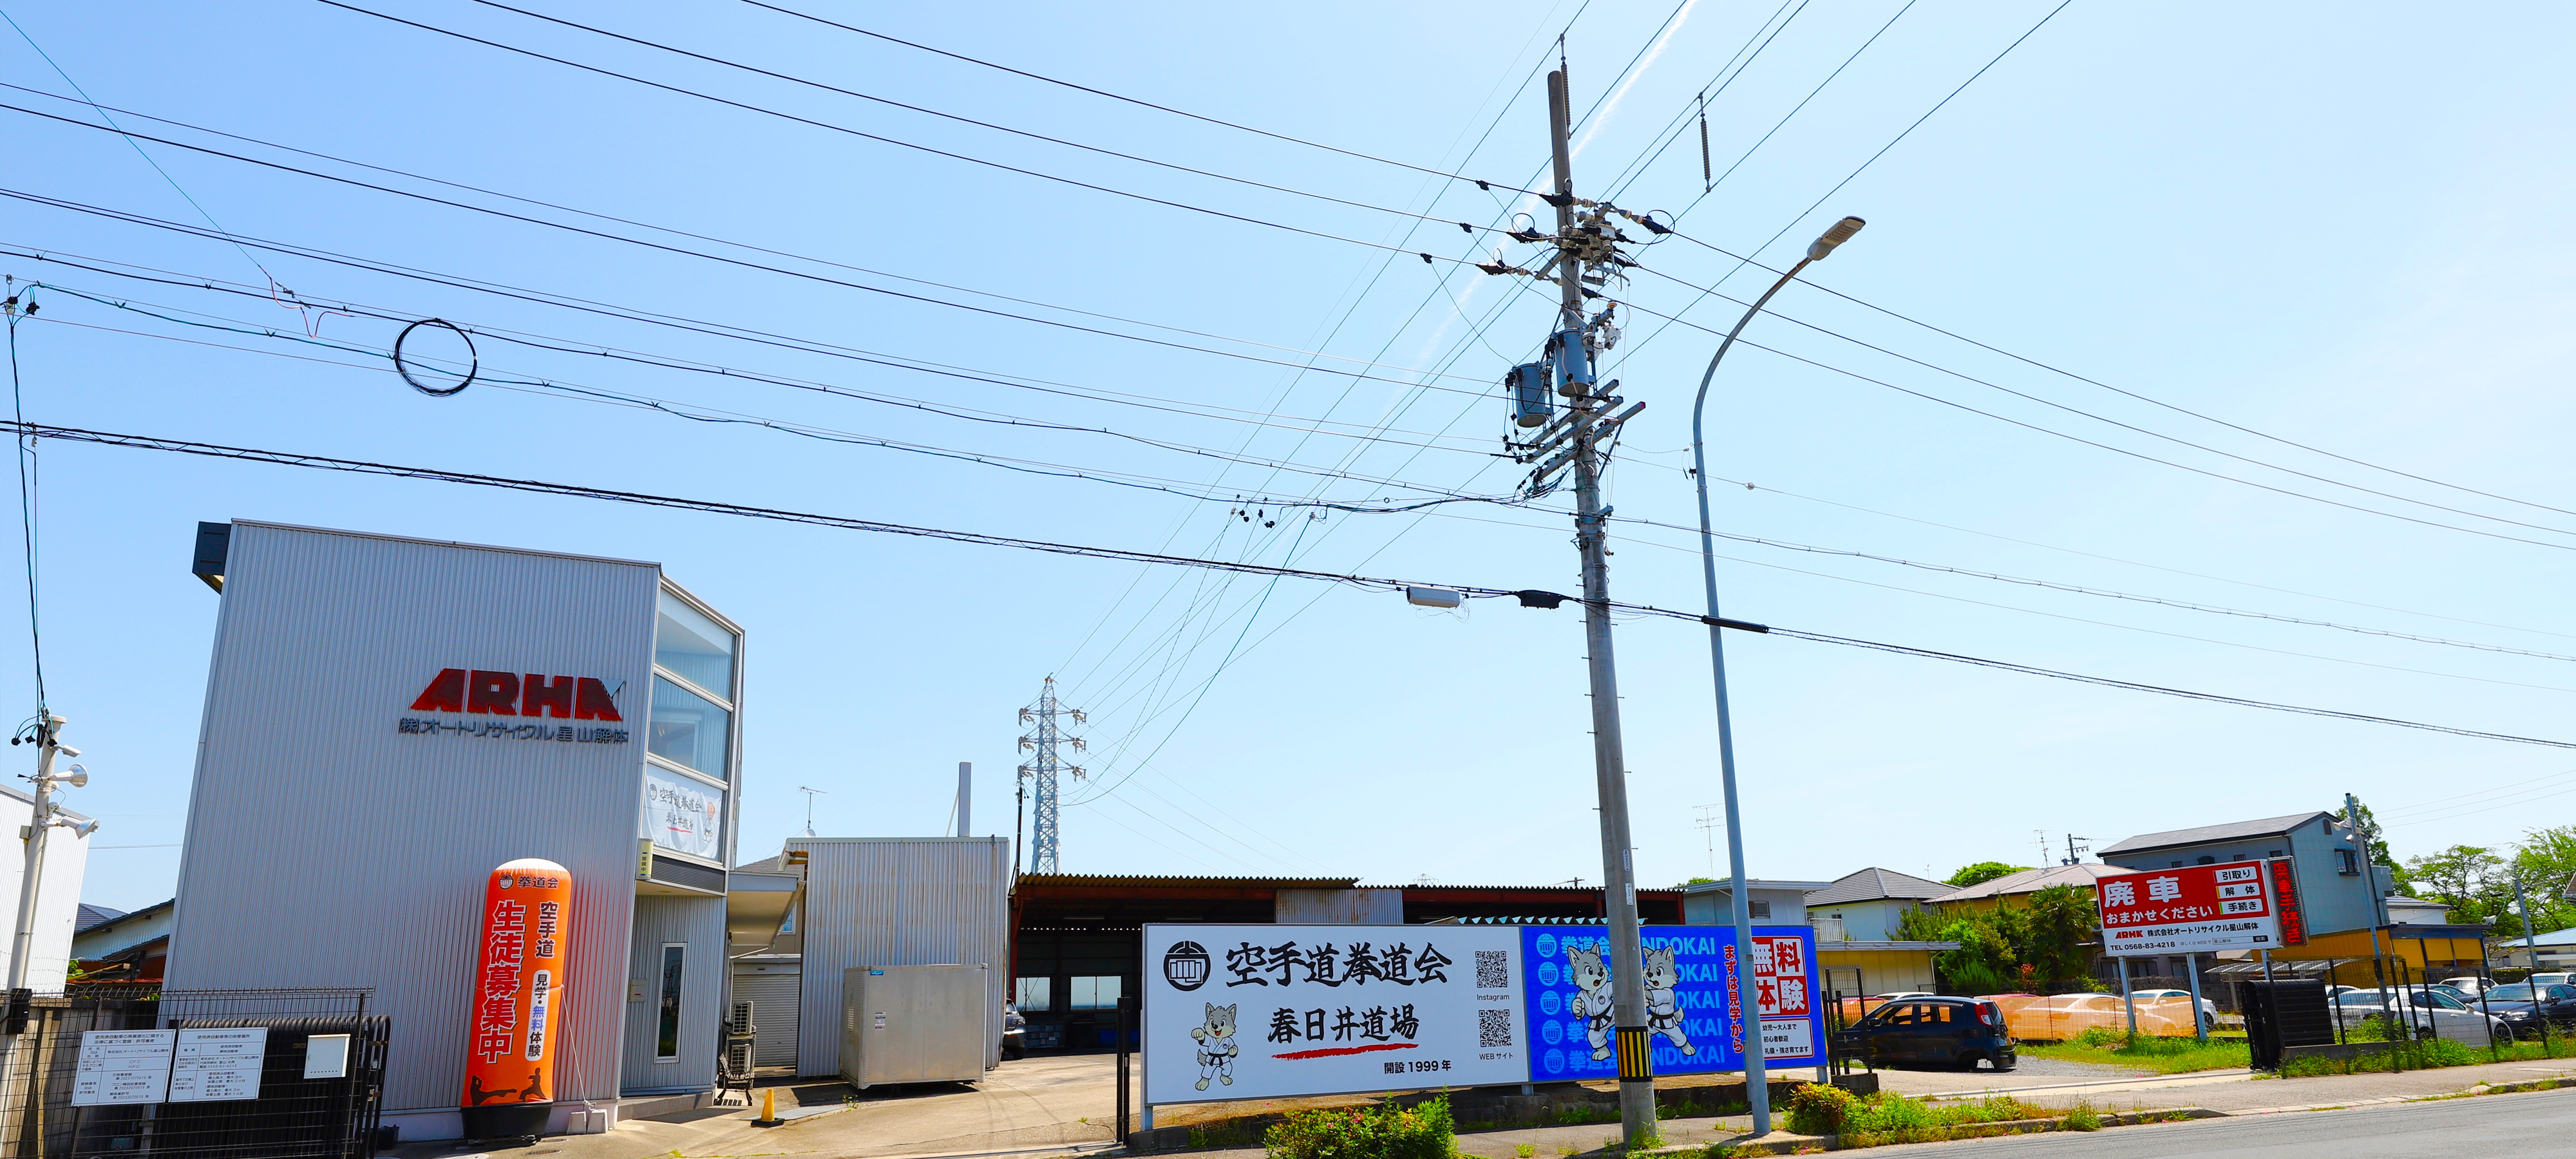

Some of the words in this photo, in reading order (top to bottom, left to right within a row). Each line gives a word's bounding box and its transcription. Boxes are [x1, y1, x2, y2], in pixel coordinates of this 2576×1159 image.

[410, 668, 624, 721] ARHA
[659, 787, 702, 813] 空手道拳道会
[517, 876, 559, 890] 拳道会
[2222, 869, 2250, 880] 引取り
[2106, 905, 2213, 925] おまかせください
[2228, 901, 2257, 912] 手続き
[535, 901, 559, 959] 空手道
[2115, 930, 2144, 939] ARHA
[2147, 922, 2259, 937] 株式会社オートリサイクル星山解体
[1642, 937, 1716, 955] NDOKAI
[2125, 941, 2175, 950] 0568-83-4218
[1226, 941, 1452, 987] 空手道拳道会
[478, 900, 526, 1064] 生徒募集中
[1723, 945, 1743, 1053] まずは見学から
[1267, 1004, 1419, 1044] 春日井道場
[1652, 1045, 1725, 1066] NDOKAI
